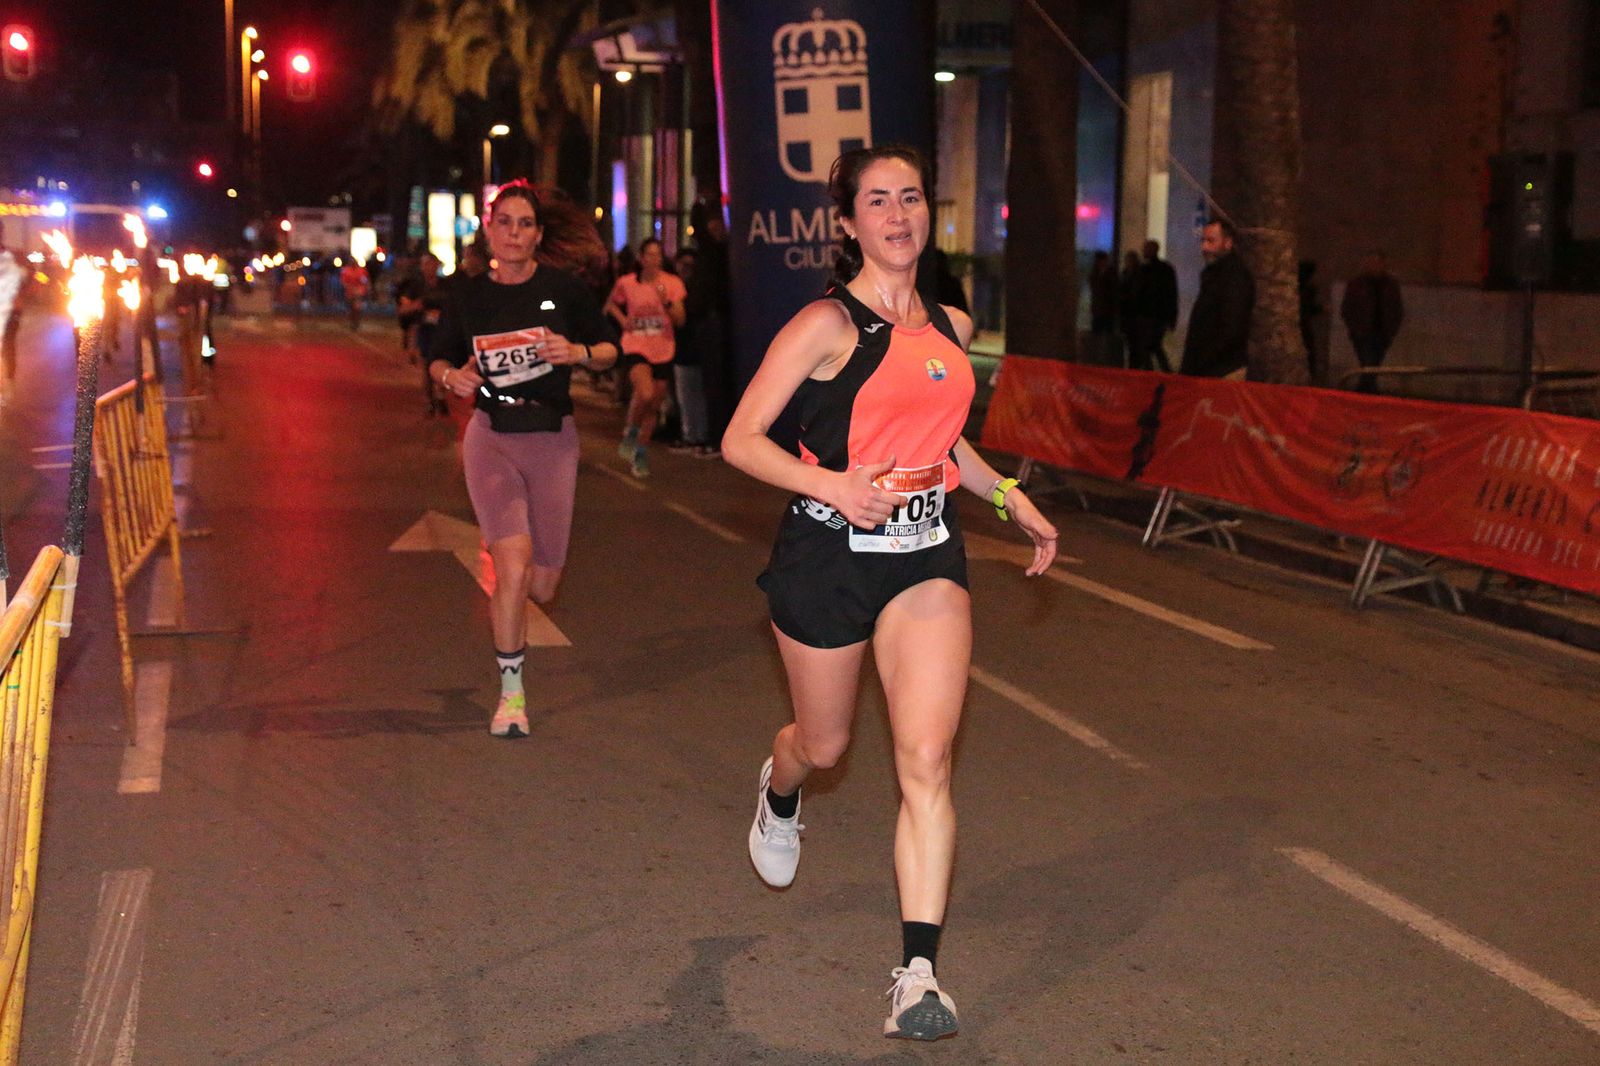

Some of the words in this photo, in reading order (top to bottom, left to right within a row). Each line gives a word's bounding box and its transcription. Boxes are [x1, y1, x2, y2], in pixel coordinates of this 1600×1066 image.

[748, 207, 845, 244] ALME
[784, 246, 844, 269] CIUD
[495, 346, 539, 368] 265
[884, 524, 917, 536] PATRICIA
